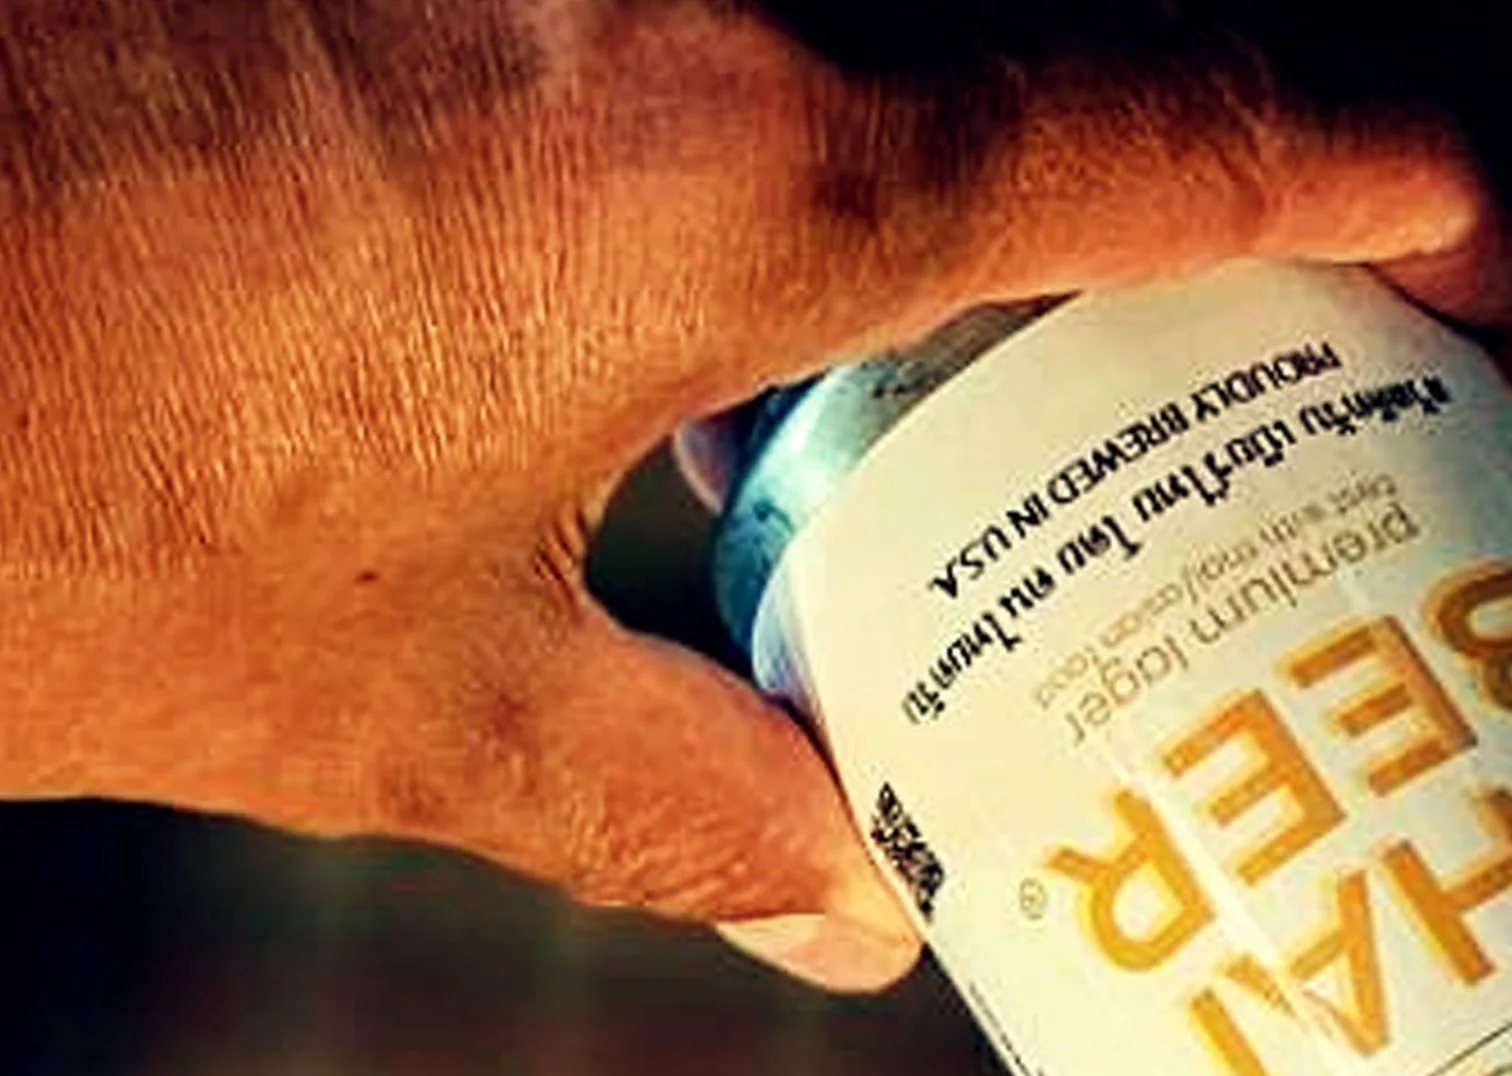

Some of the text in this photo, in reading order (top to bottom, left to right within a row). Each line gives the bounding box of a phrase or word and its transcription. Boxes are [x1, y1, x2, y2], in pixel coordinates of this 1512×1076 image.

[1191, 339, 1343, 424] PROUDLY
[1047, 403, 1190, 505] BREWED
[1005, 492, 1056, 543] IN
[1062, 503, 1421, 746] premium lager
